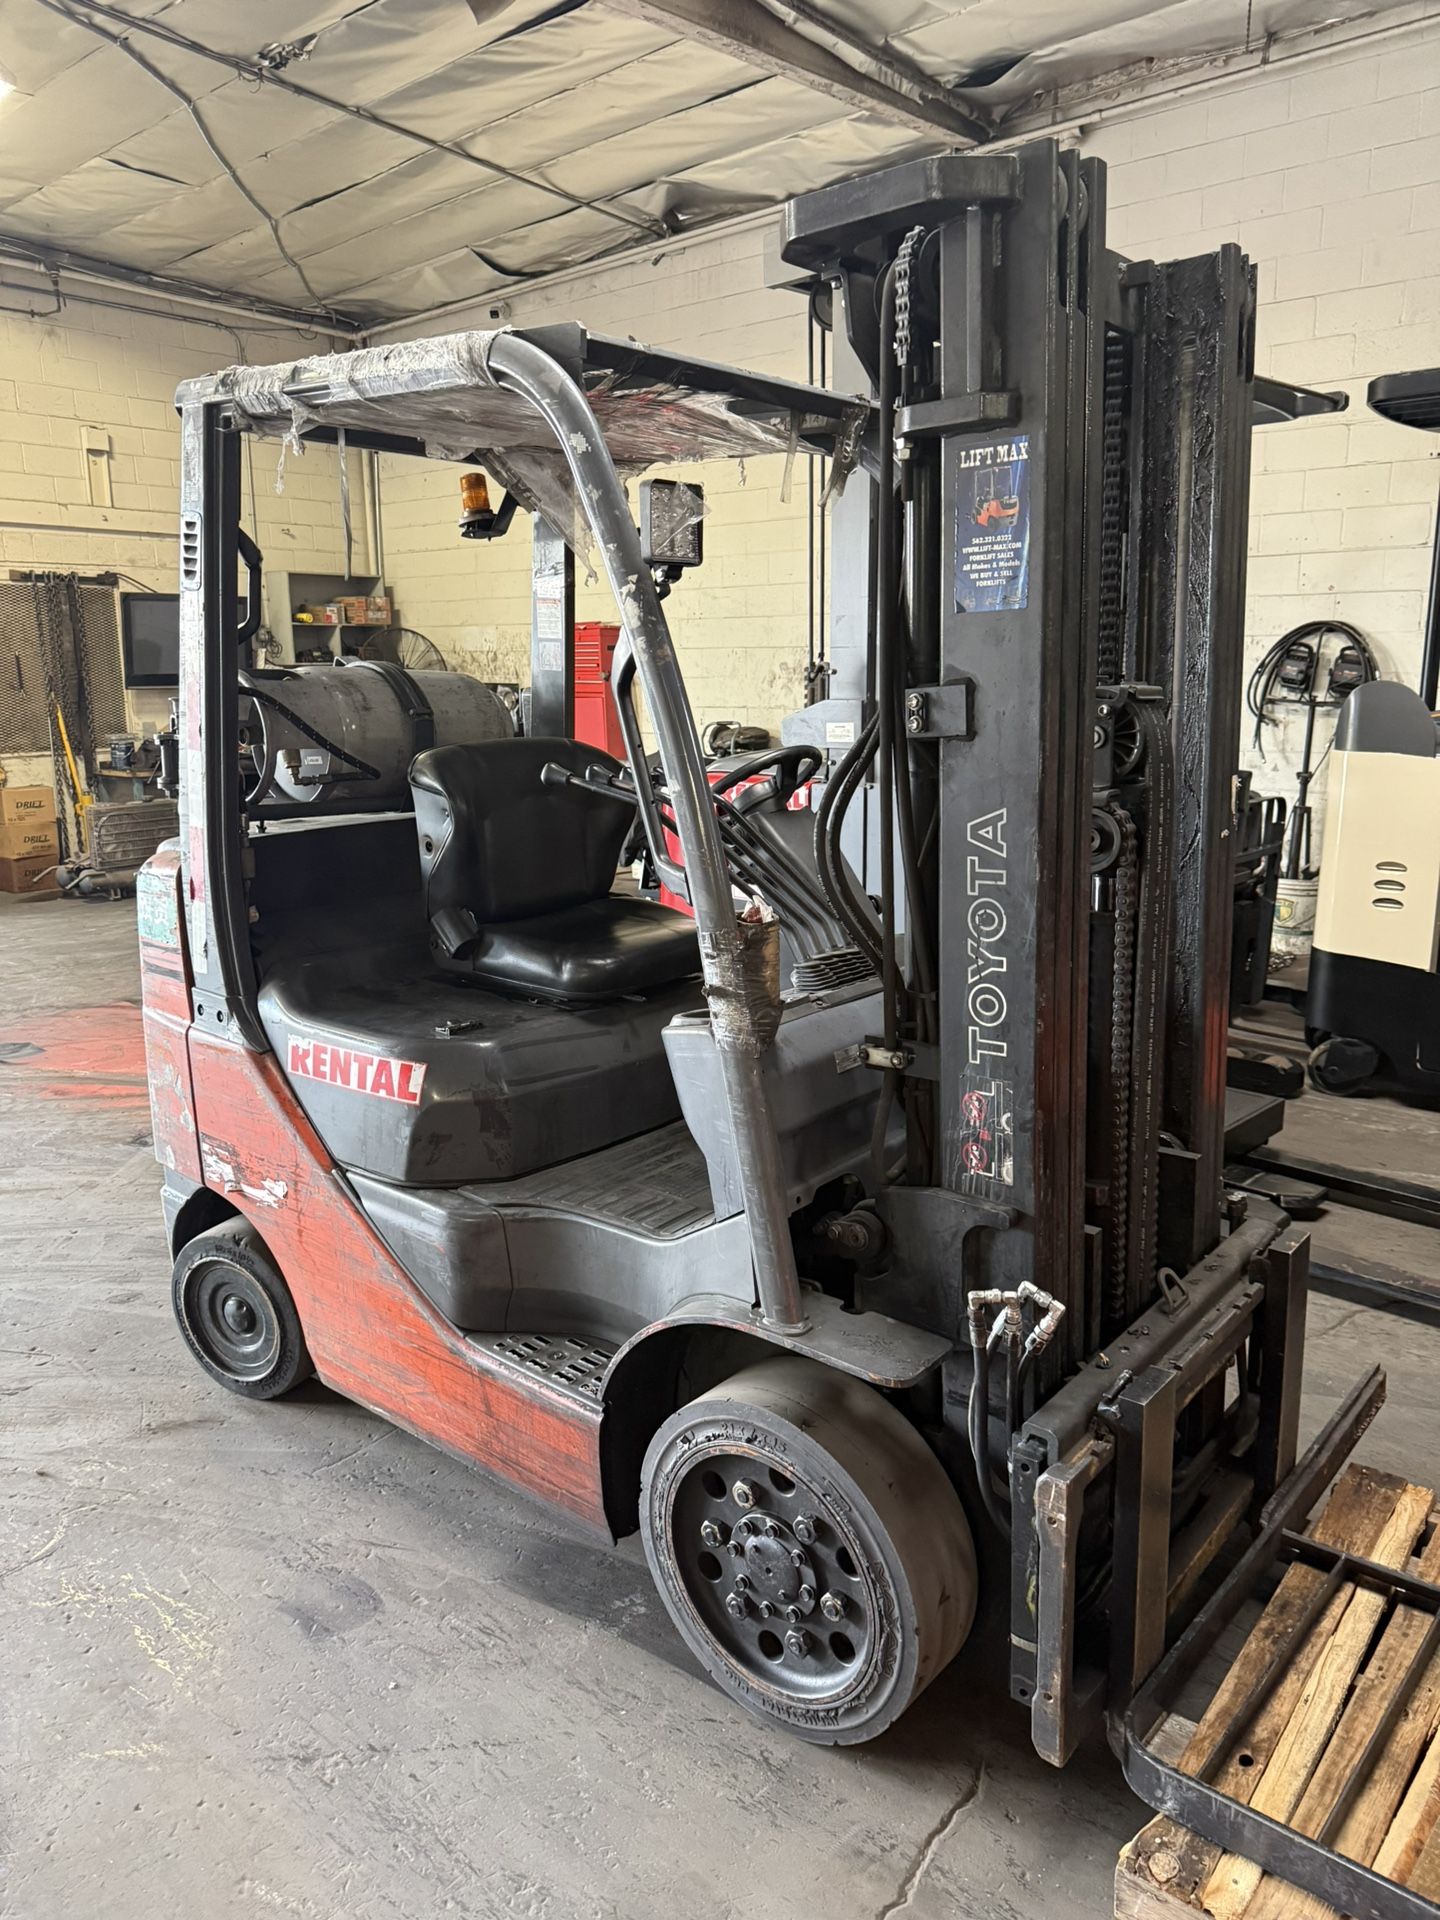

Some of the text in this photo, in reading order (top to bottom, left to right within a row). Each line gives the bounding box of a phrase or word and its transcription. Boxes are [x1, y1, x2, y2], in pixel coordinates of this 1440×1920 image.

[960, 441, 1029, 469] LIFT MAX
[969, 552, 996, 562] FORKLIFT
[967, 807, 1007, 1065] TOYOTA
[290, 1042, 418, 1102] RENTAL
